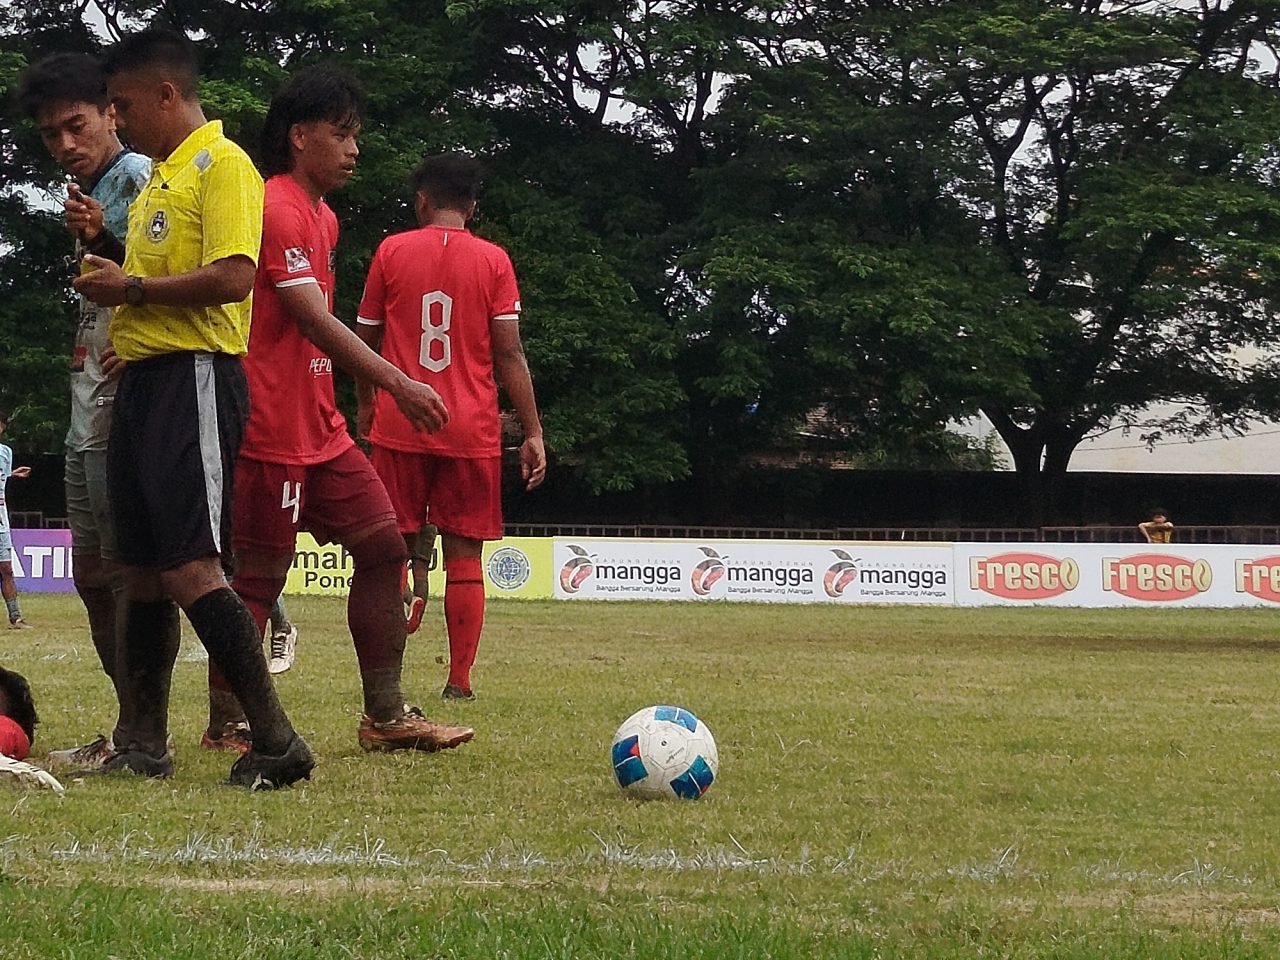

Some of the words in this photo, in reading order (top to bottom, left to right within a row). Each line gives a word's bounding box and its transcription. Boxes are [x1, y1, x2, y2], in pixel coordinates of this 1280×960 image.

[418, 290, 453, 373] 8
[281, 481, 302, 524] 4
[595, 565, 681, 585] mangga
[727, 567, 814, 587] mangga
[860, 569, 947, 589] mangga
[969, 556, 1080, 591] Fresco
[1101, 557, 1213, 592] Fresco
